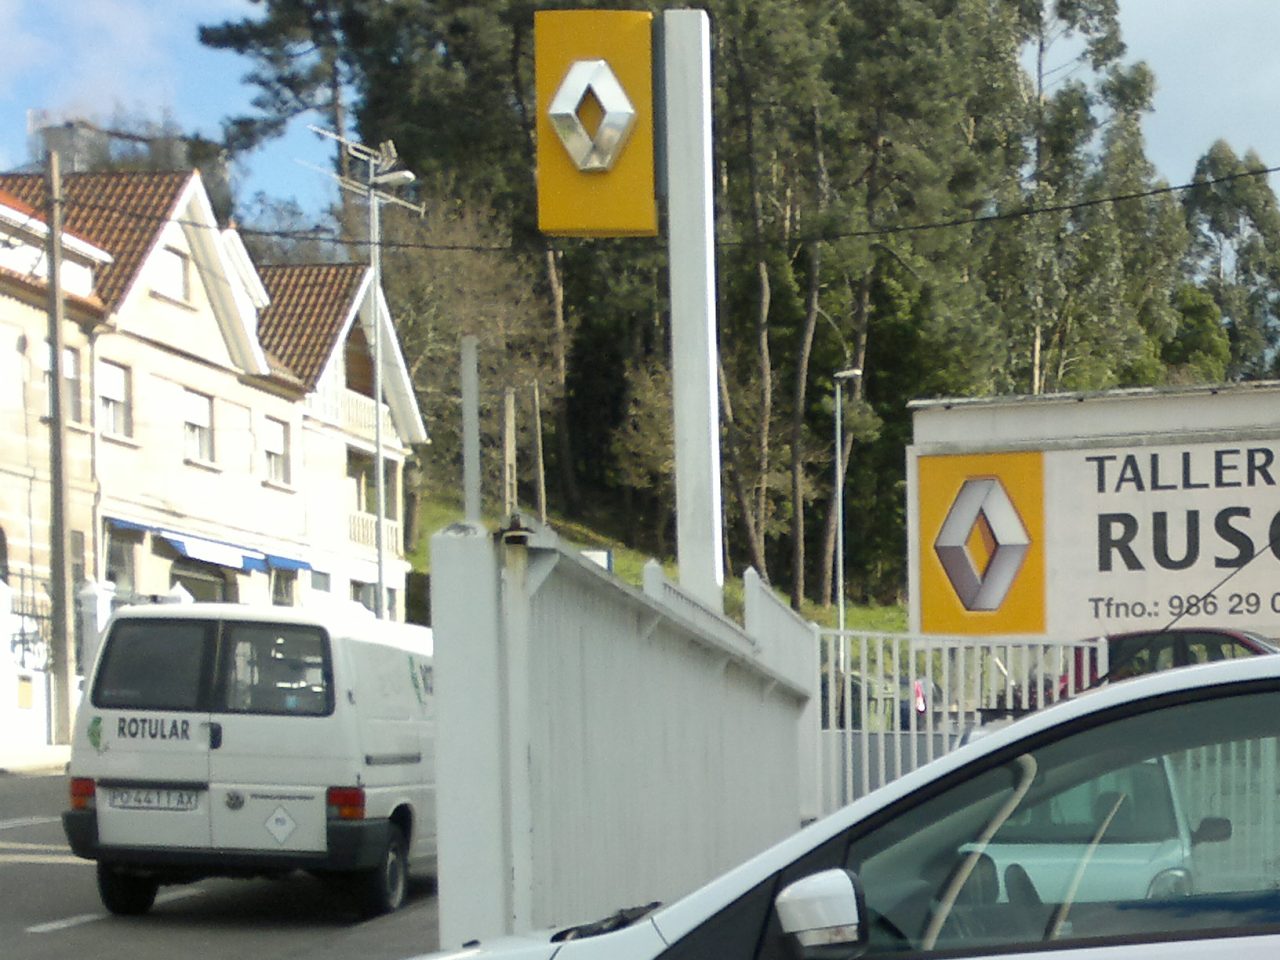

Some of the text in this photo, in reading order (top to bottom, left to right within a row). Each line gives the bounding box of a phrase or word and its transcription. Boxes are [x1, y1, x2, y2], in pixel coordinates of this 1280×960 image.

[1088, 597, 1160, 619] Tfno.:
[1167, 595, 1219, 617] 986
[1227, 593, 1261, 615] 29
[117, 717, 191, 740] ROTULAR
